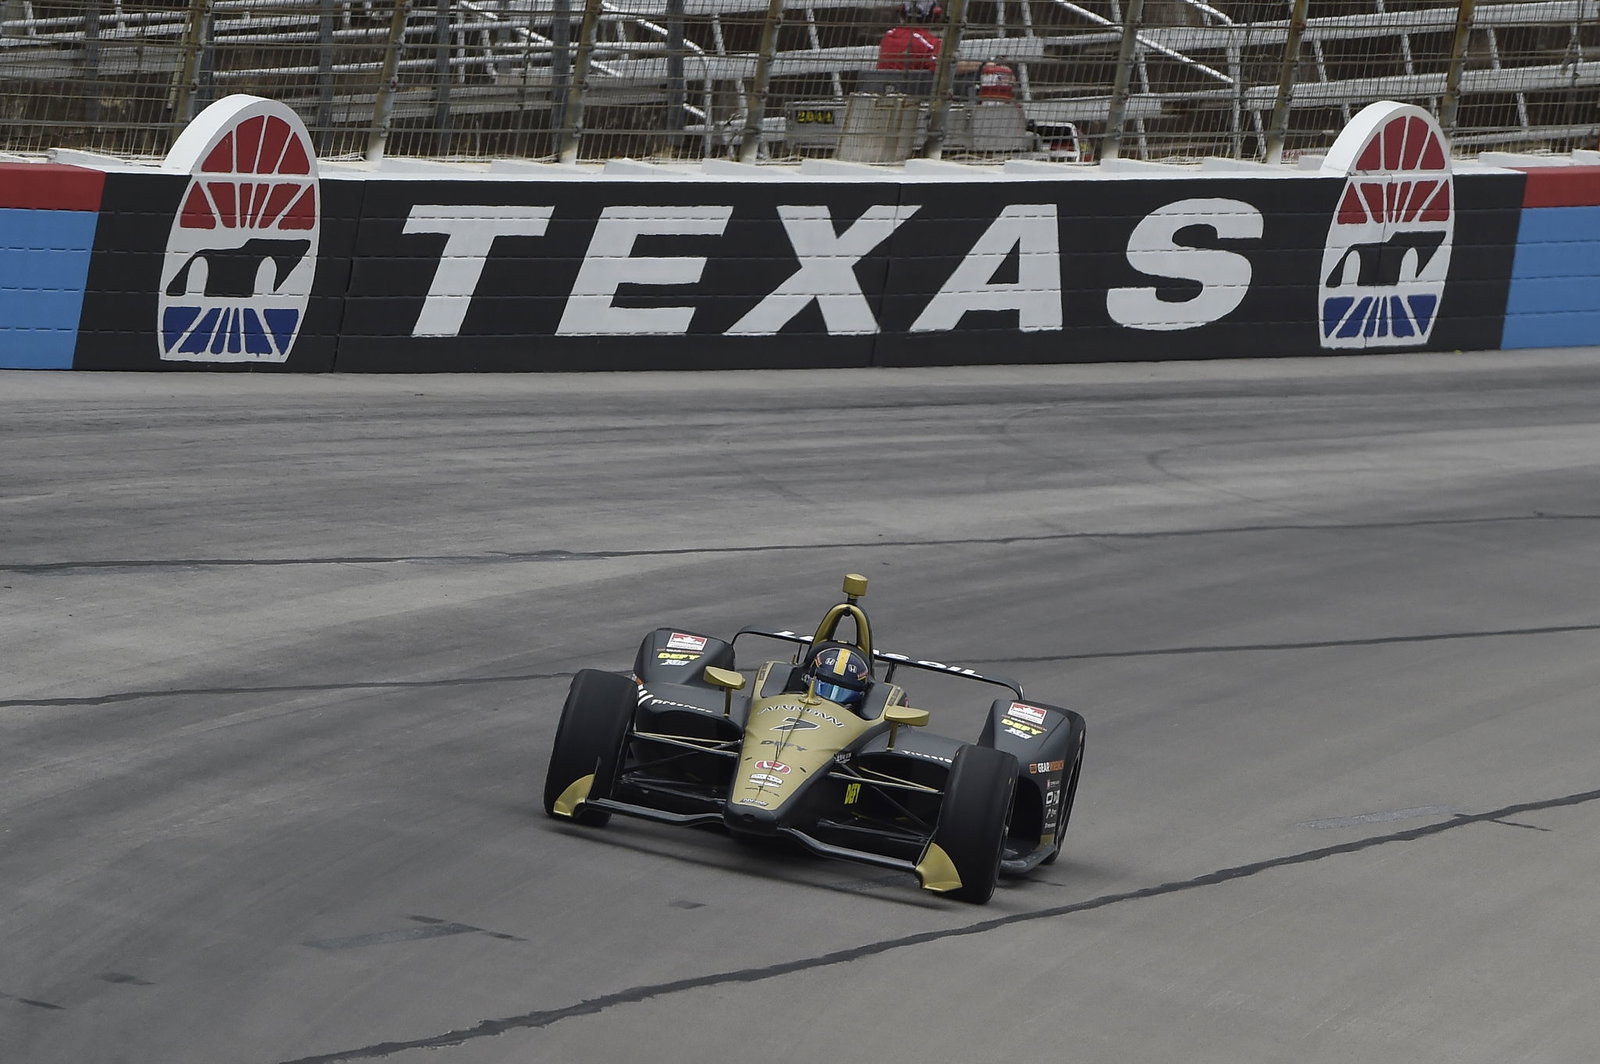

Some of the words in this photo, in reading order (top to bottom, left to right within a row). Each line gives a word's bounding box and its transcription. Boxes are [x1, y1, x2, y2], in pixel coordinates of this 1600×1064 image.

[402, 198, 1264, 338] TEXAS
[657, 652, 701, 660] DEFY
[769, 717, 821, 731] 7
[1001, 718, 1043, 736] DEFY
